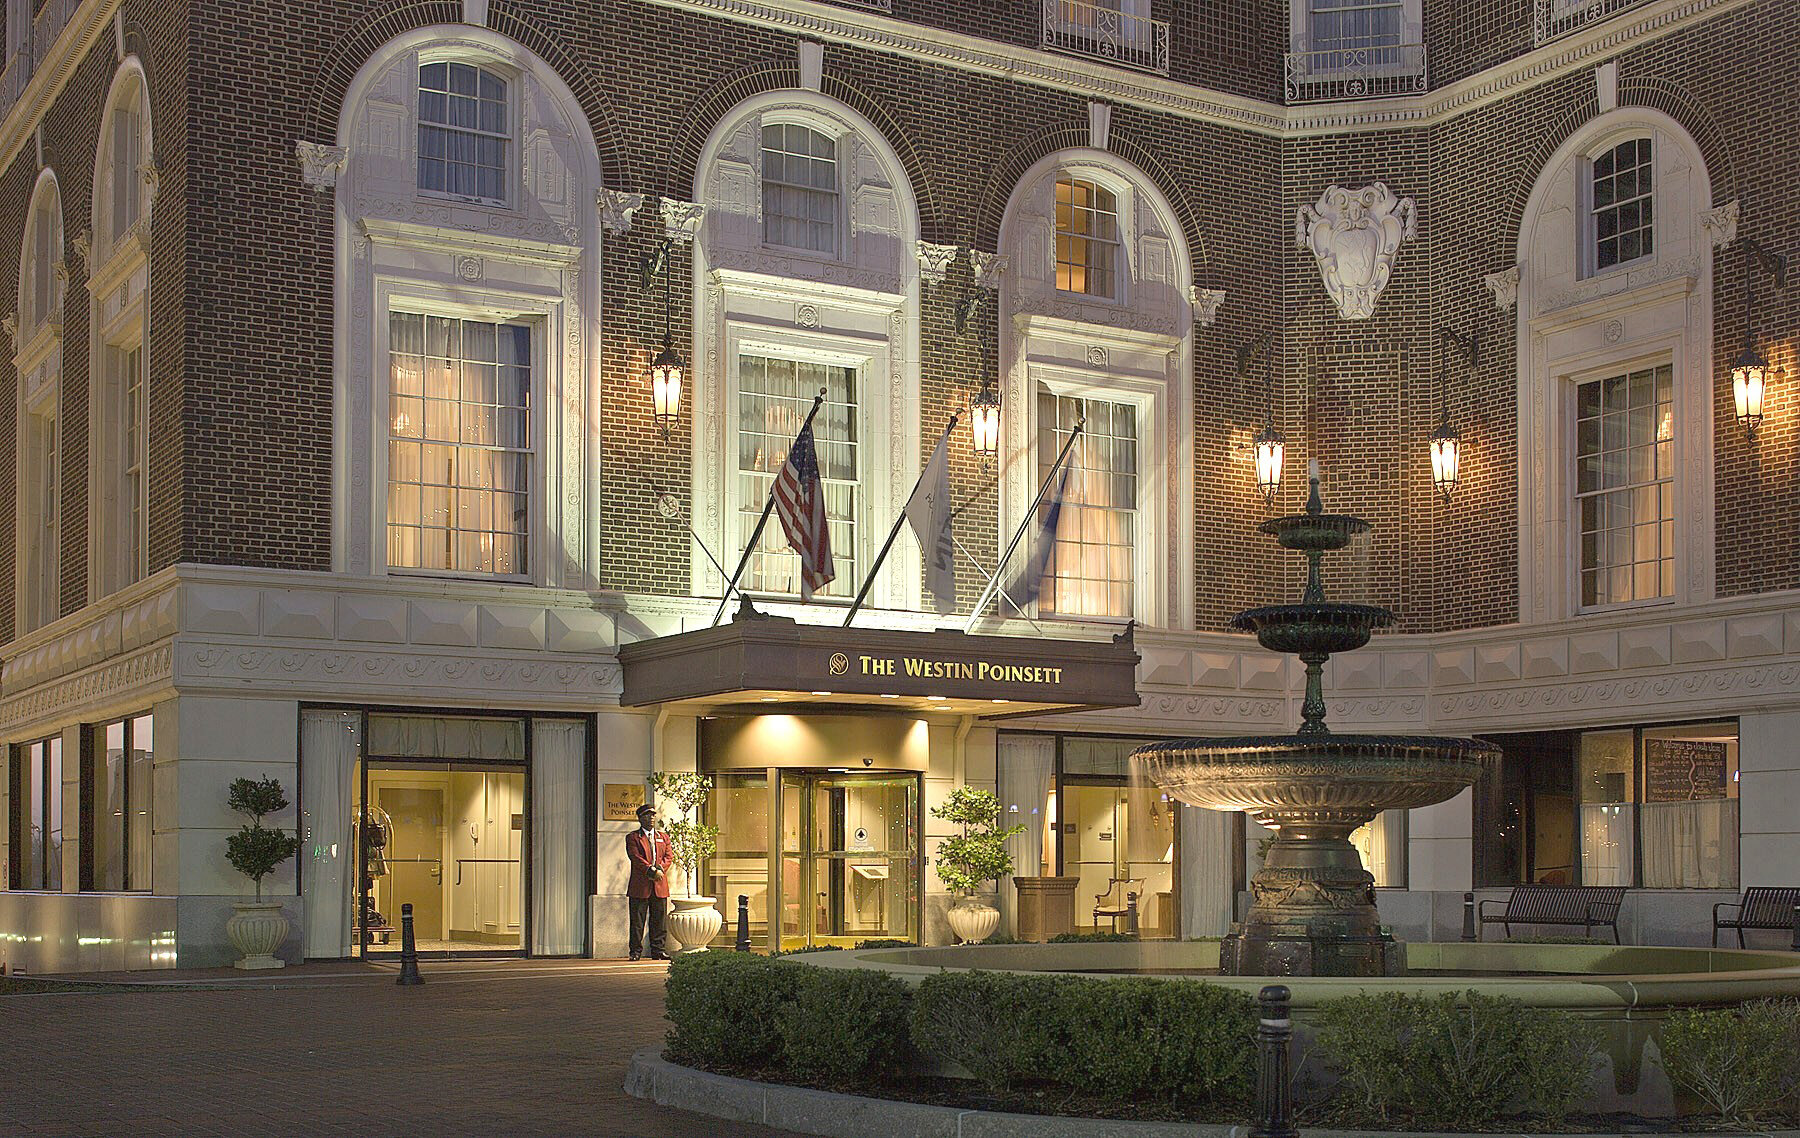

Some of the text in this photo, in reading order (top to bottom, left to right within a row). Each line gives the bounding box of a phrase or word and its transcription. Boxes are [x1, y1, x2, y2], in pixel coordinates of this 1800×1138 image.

[858, 655, 1062, 684] THE WESTIN POINSETT
